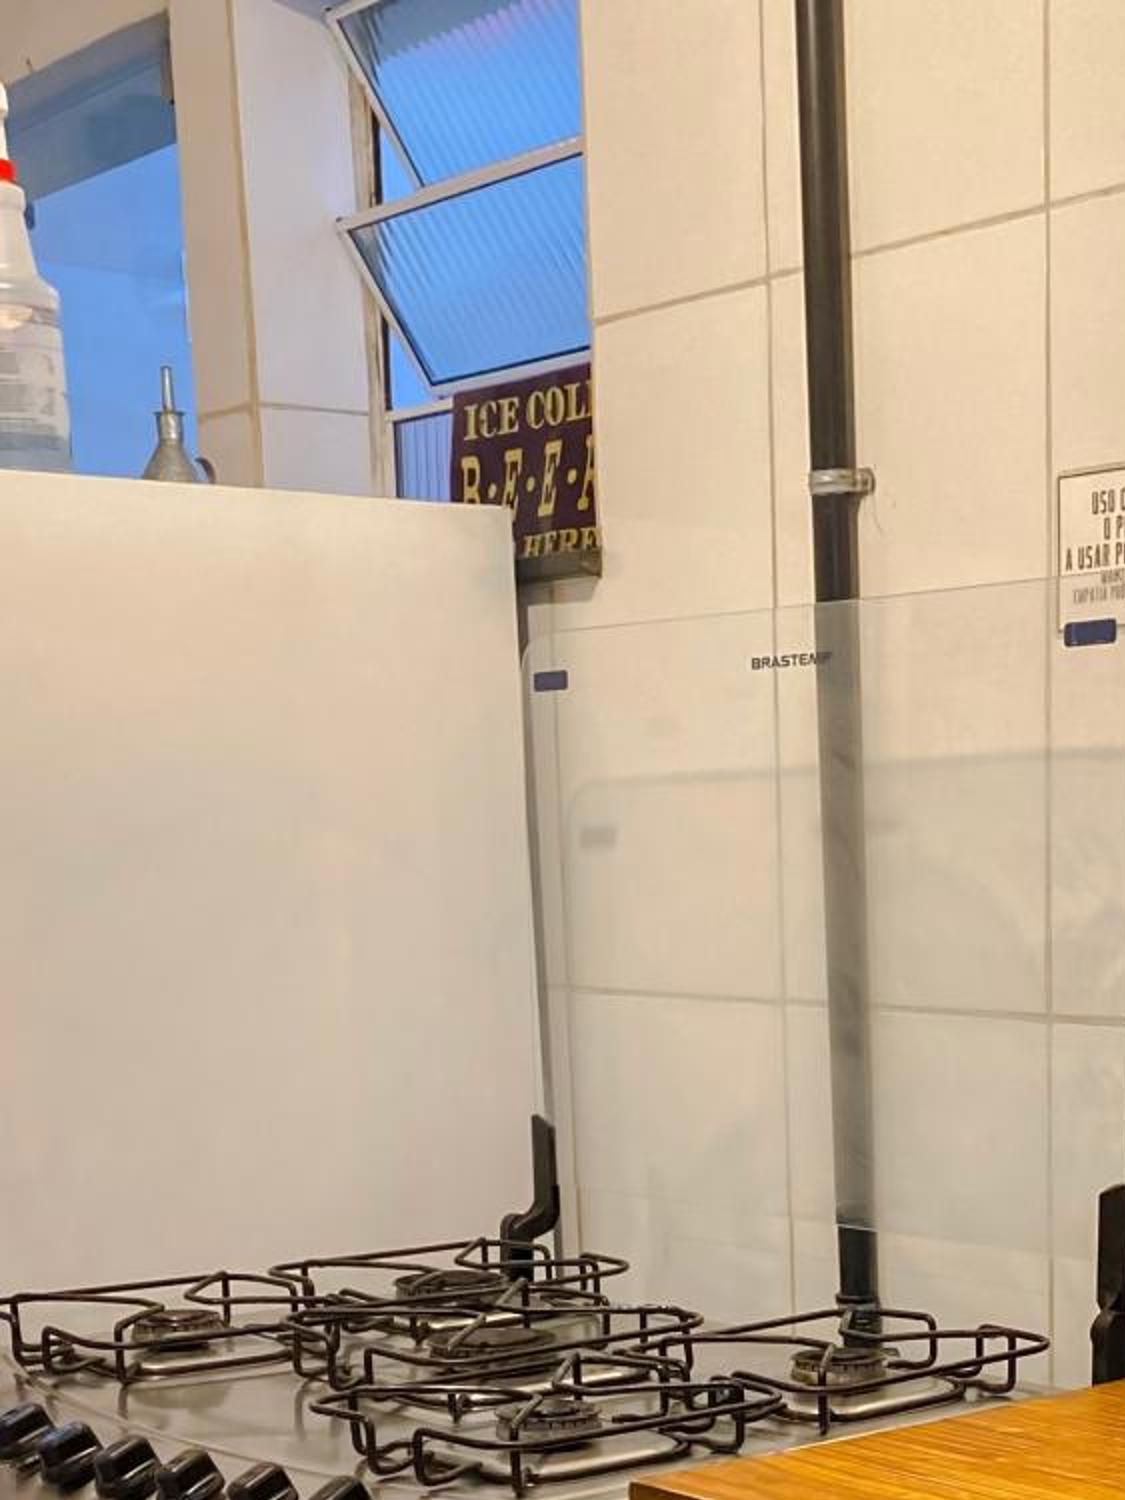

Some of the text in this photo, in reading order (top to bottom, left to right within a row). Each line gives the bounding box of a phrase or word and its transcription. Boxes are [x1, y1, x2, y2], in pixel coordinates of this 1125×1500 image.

[464, 396, 520, 441] ICE
[1091, 488, 1116, 515] USO
[1104, 516, 1111, 540] O
[1065, 547, 1073, 571] A
[1077, 543, 1109, 570] USAR
